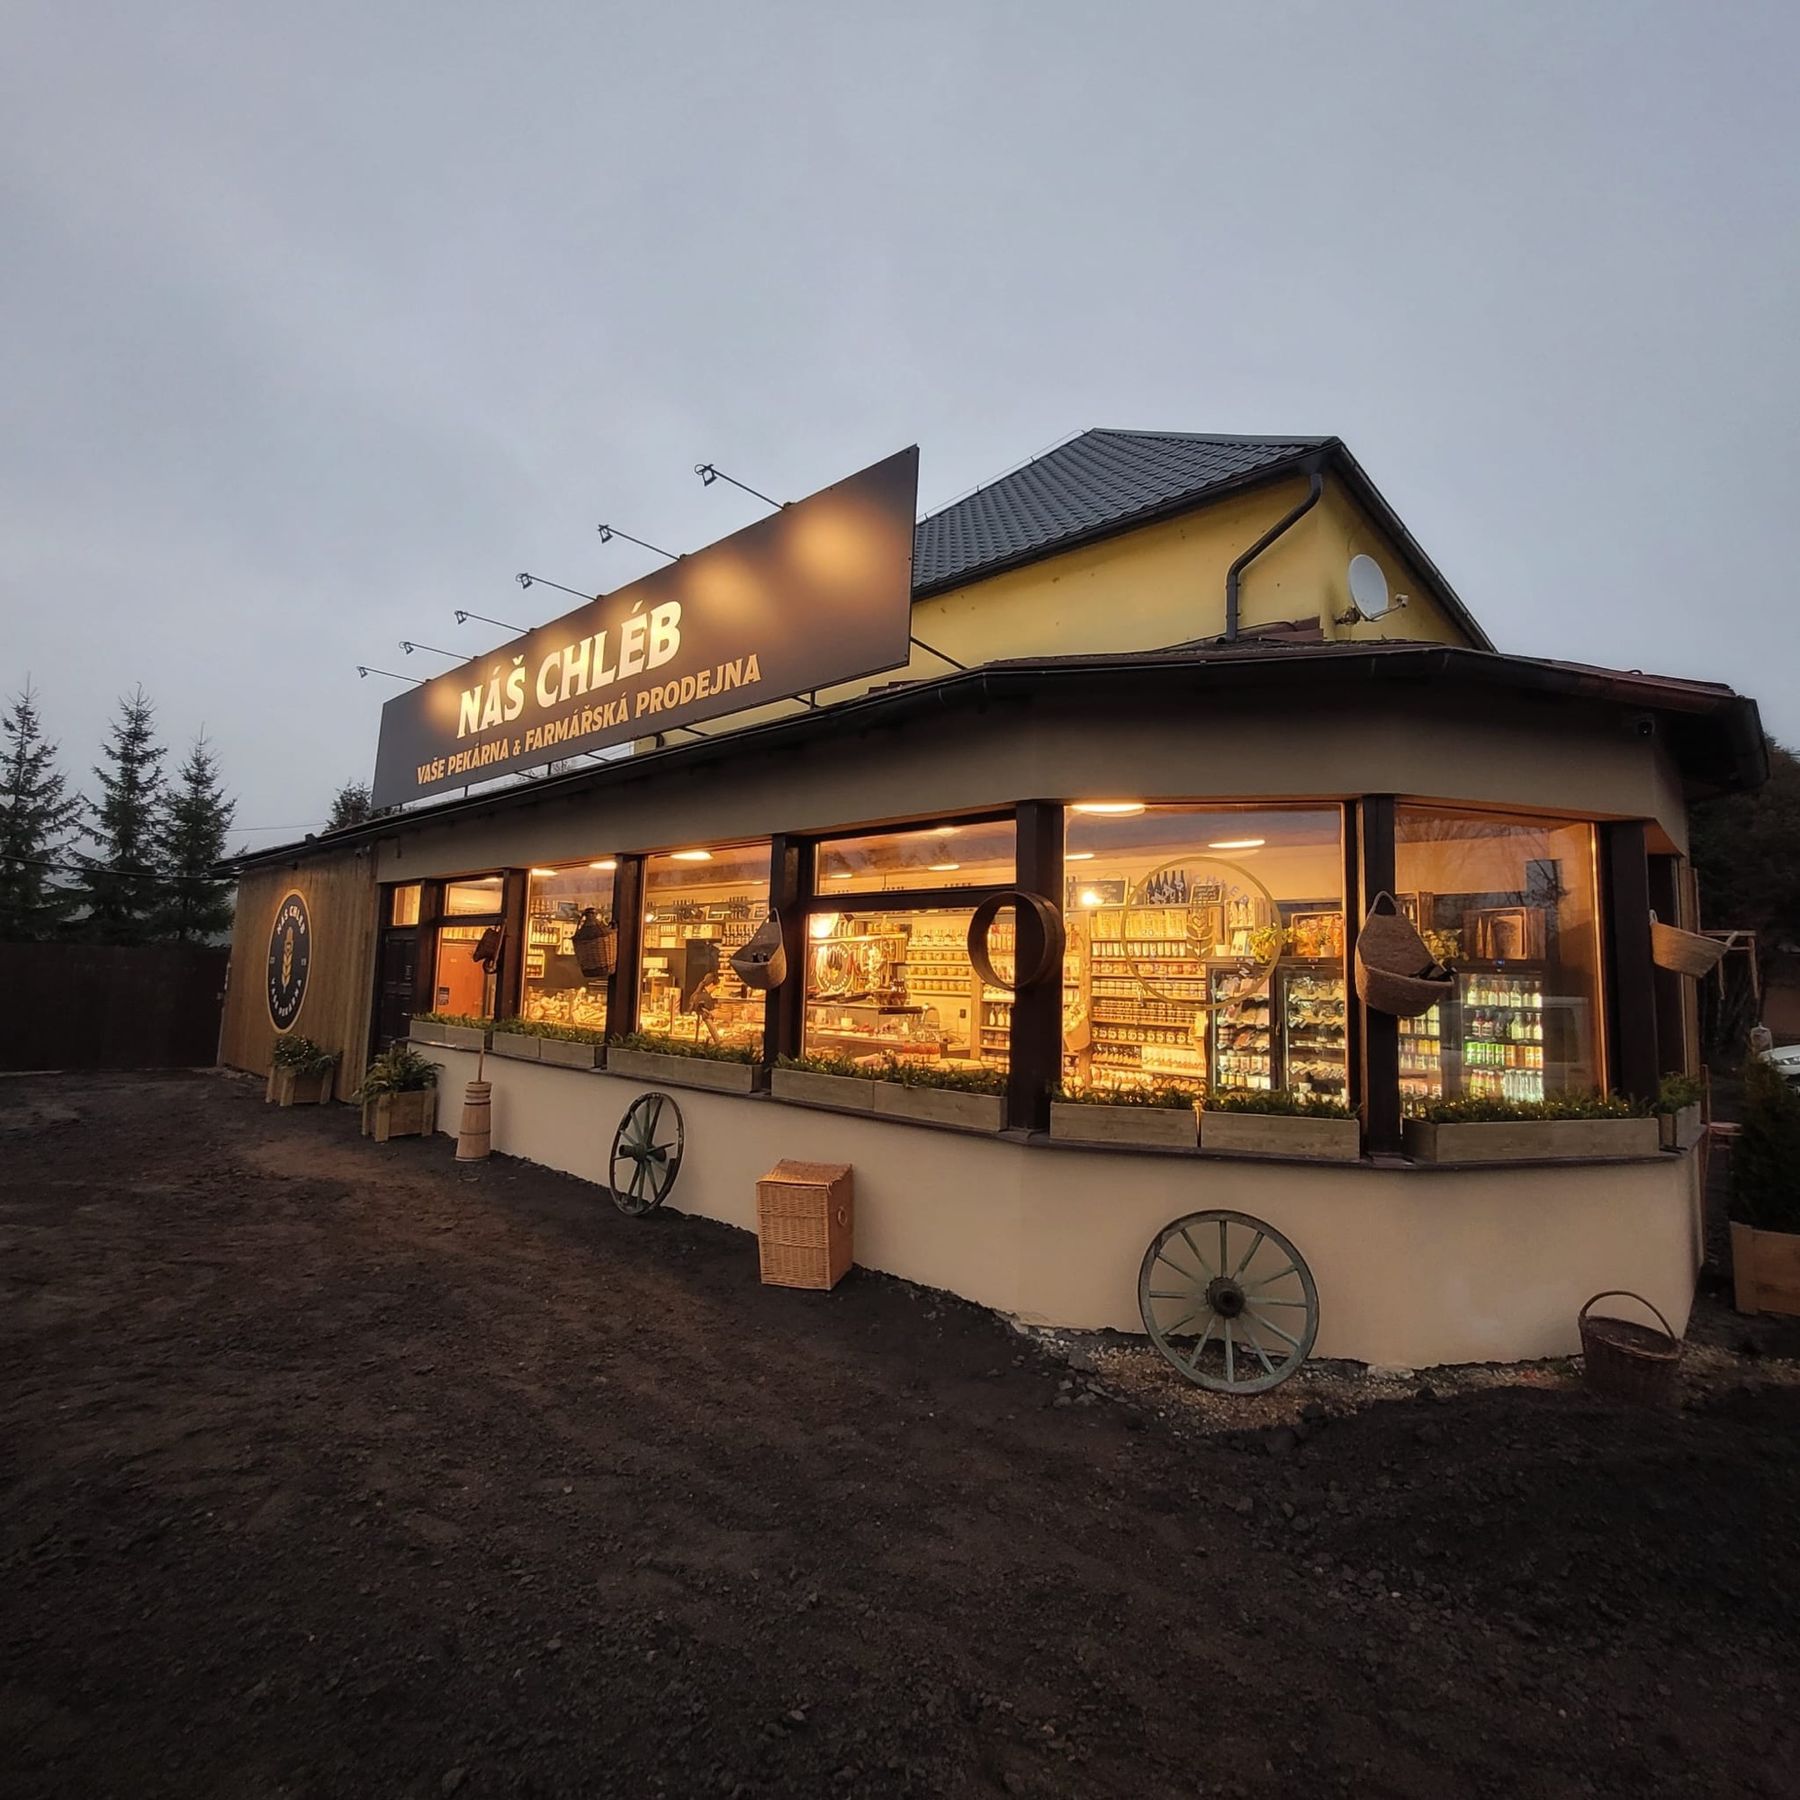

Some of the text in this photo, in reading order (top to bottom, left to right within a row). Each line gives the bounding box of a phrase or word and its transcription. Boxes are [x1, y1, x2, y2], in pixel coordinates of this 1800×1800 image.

[417, 653, 761, 784] VAŠE PEKÁRNA & FARMÁŘSKÁ PRODEJNA
[457, 600, 682, 739] NÁŠ CHLÉB
